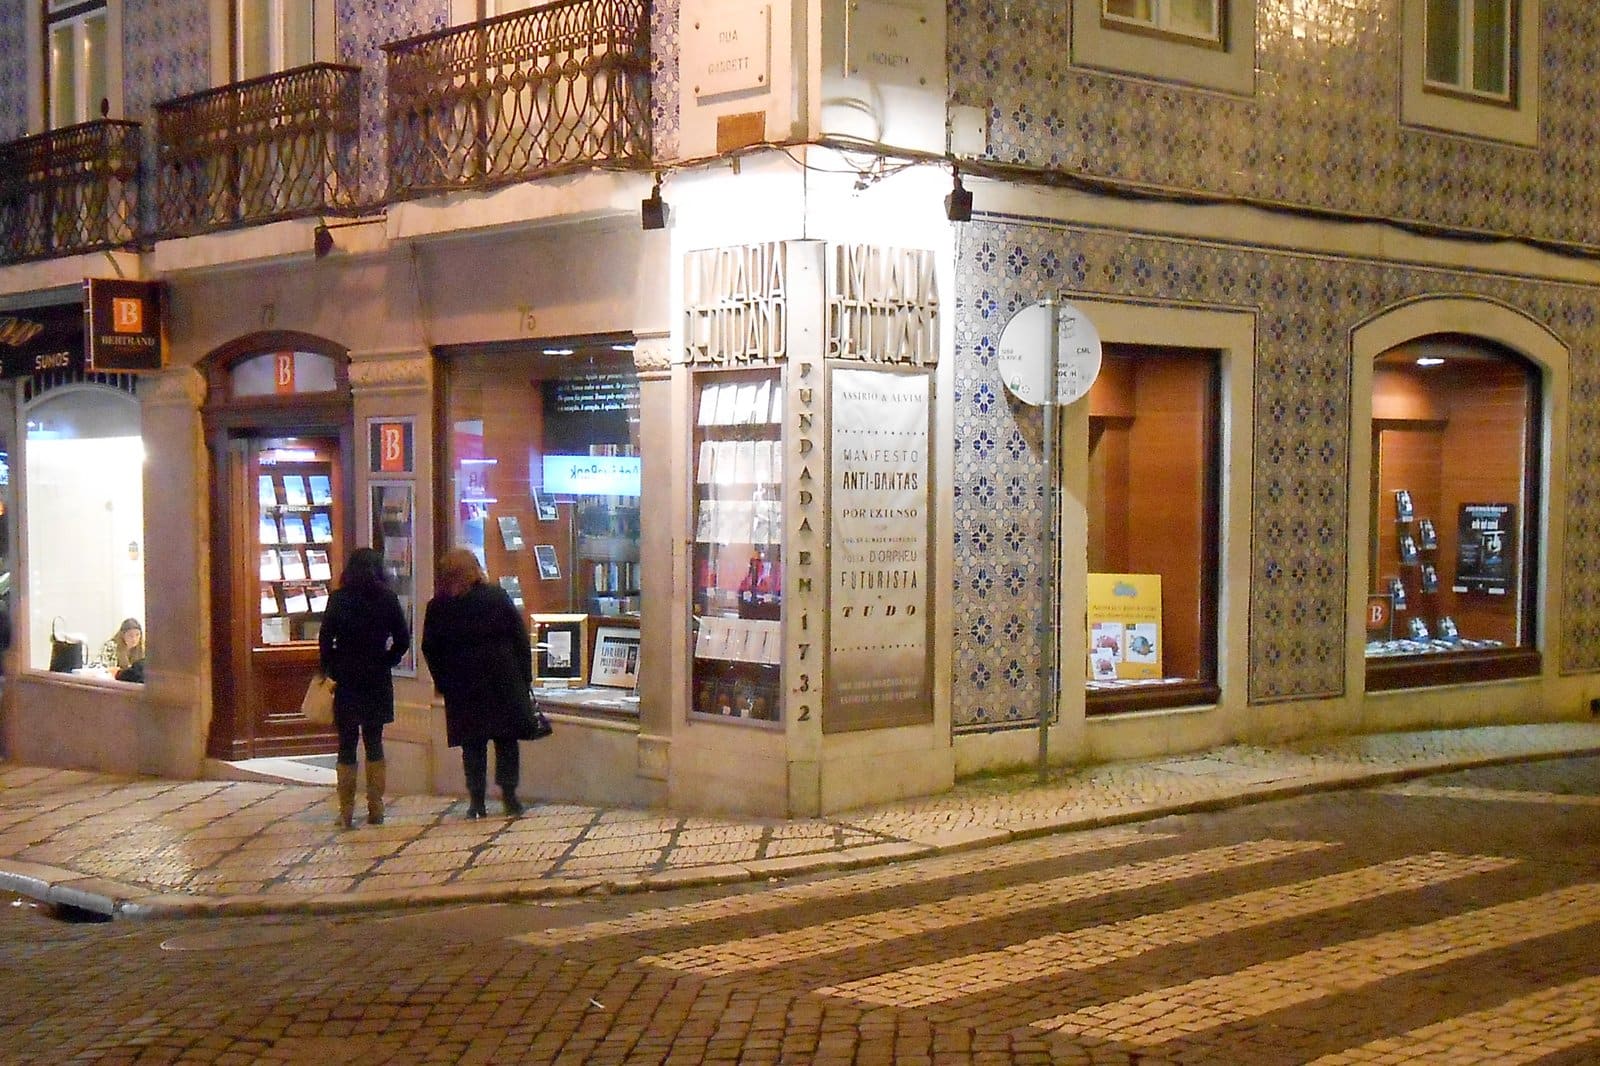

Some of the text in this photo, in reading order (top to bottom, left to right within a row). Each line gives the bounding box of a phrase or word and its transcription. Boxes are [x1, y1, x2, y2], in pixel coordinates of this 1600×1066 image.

[121, 301, 138, 325] B
[101, 335, 155, 346] BERTRAND
[683, 299, 787, 363] BERTRAND
[825, 297, 940, 366] BERTRAND
[35, 351, 70, 370] SUMOS
[278, 355, 291, 386] B
[891, 393, 922, 403] ALVIM
[385, 428, 400, 461] B
[843, 448, 919, 463] MANIFESTO
[843, 471, 918, 490] ANTI-DANTAS
[843, 508, 918, 518] POR EXTENSO
[841, 570, 917, 590] FUTURISTA
[842, 605, 916, 618] TUDO
